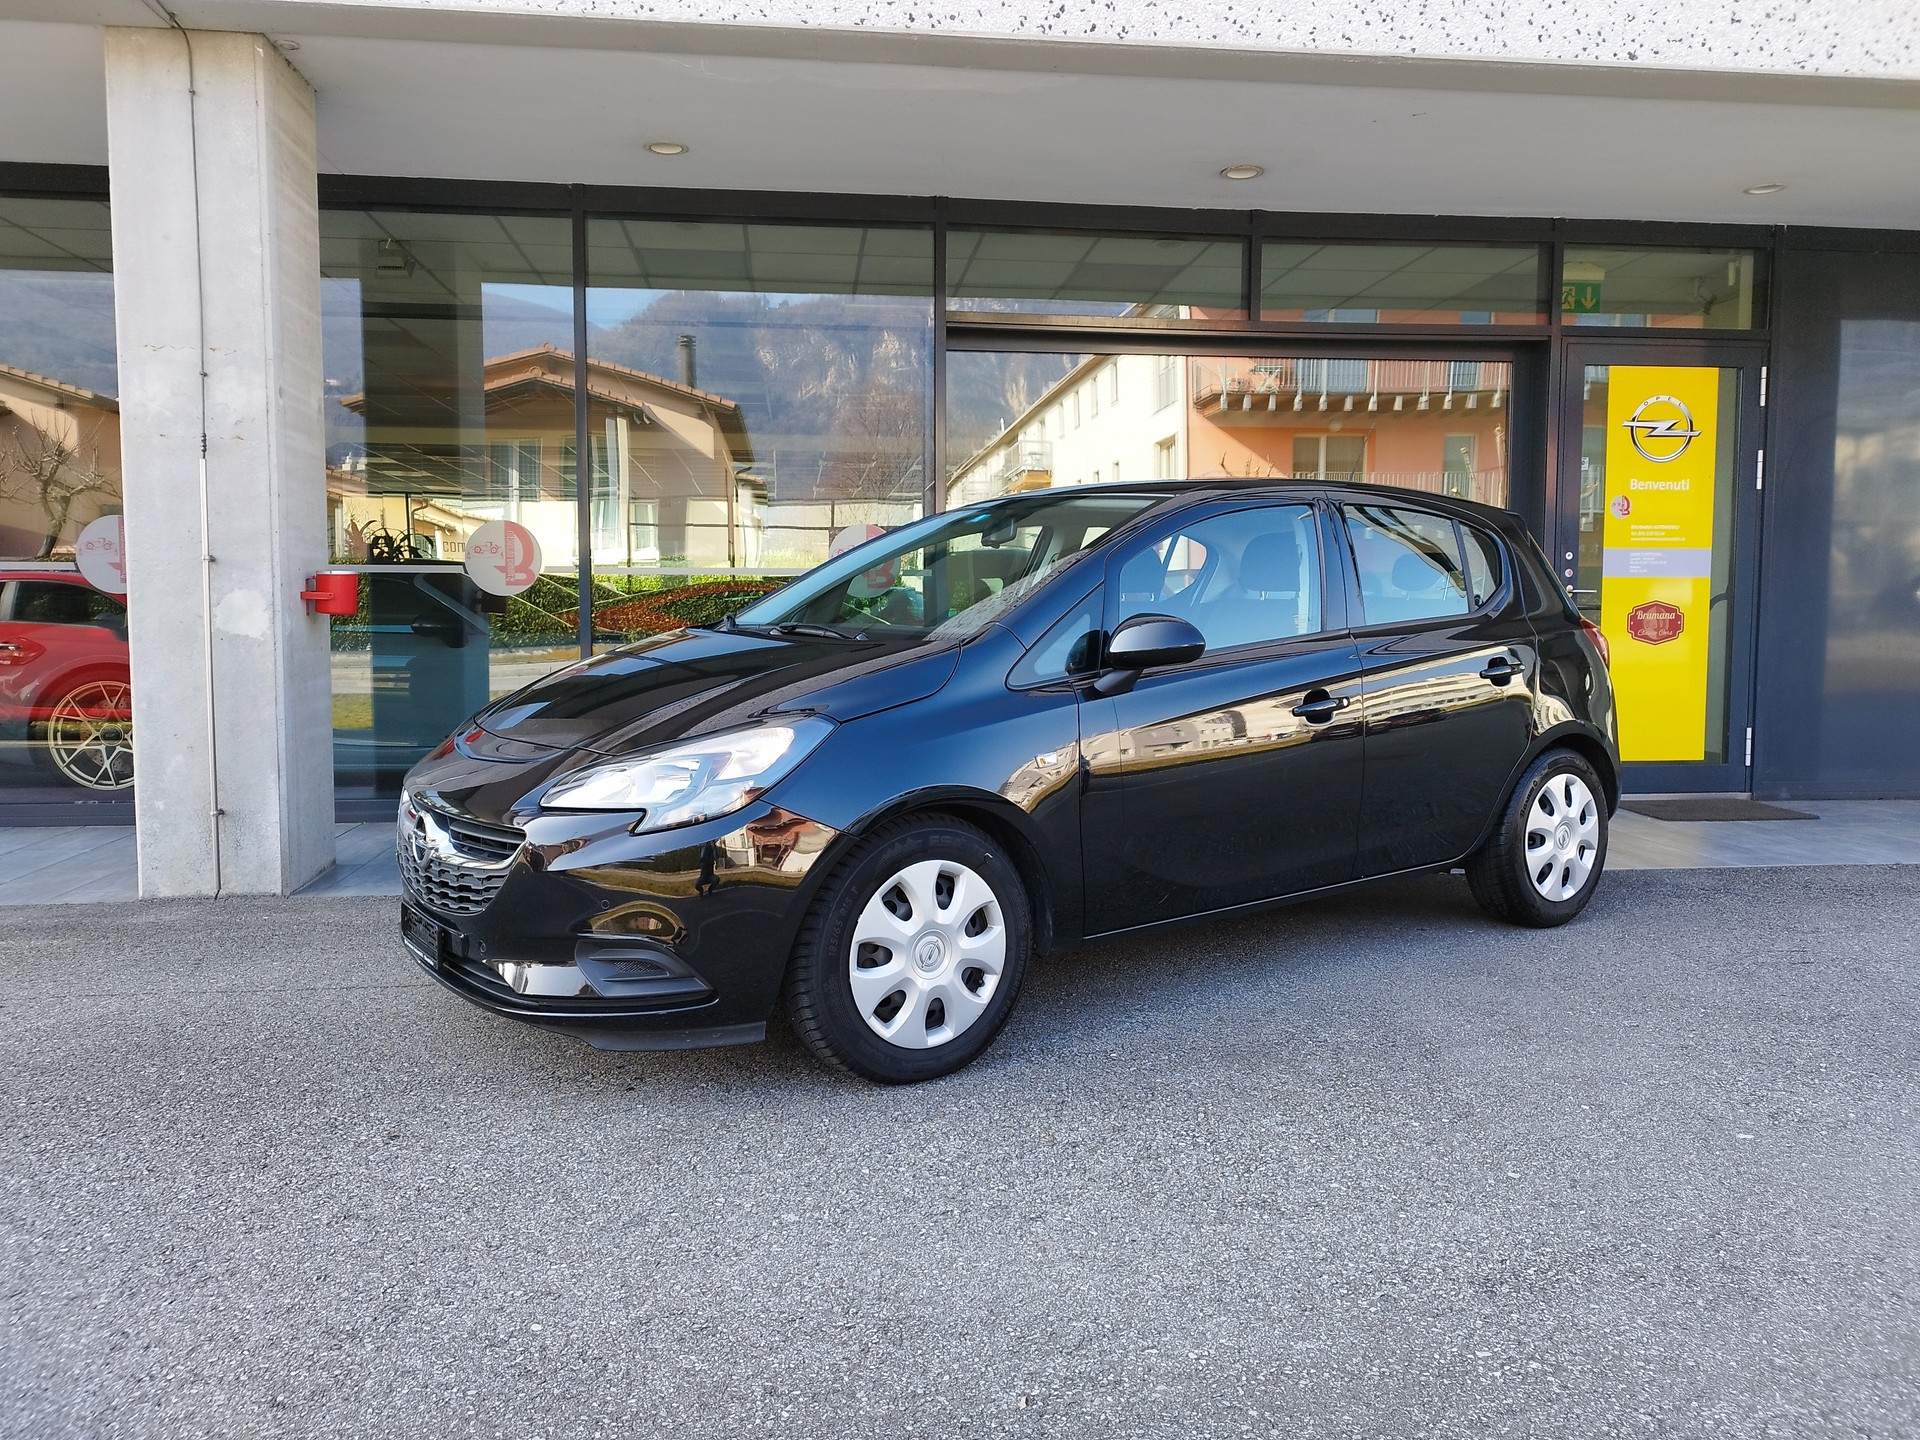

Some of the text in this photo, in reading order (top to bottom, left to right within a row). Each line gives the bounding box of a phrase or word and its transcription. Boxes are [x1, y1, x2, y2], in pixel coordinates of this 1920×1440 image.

[1644, 396, 1682, 407] OPEL
[1630, 479, 1690, 490] Benvenuti
[1636, 610, 1676, 620] Brumana
